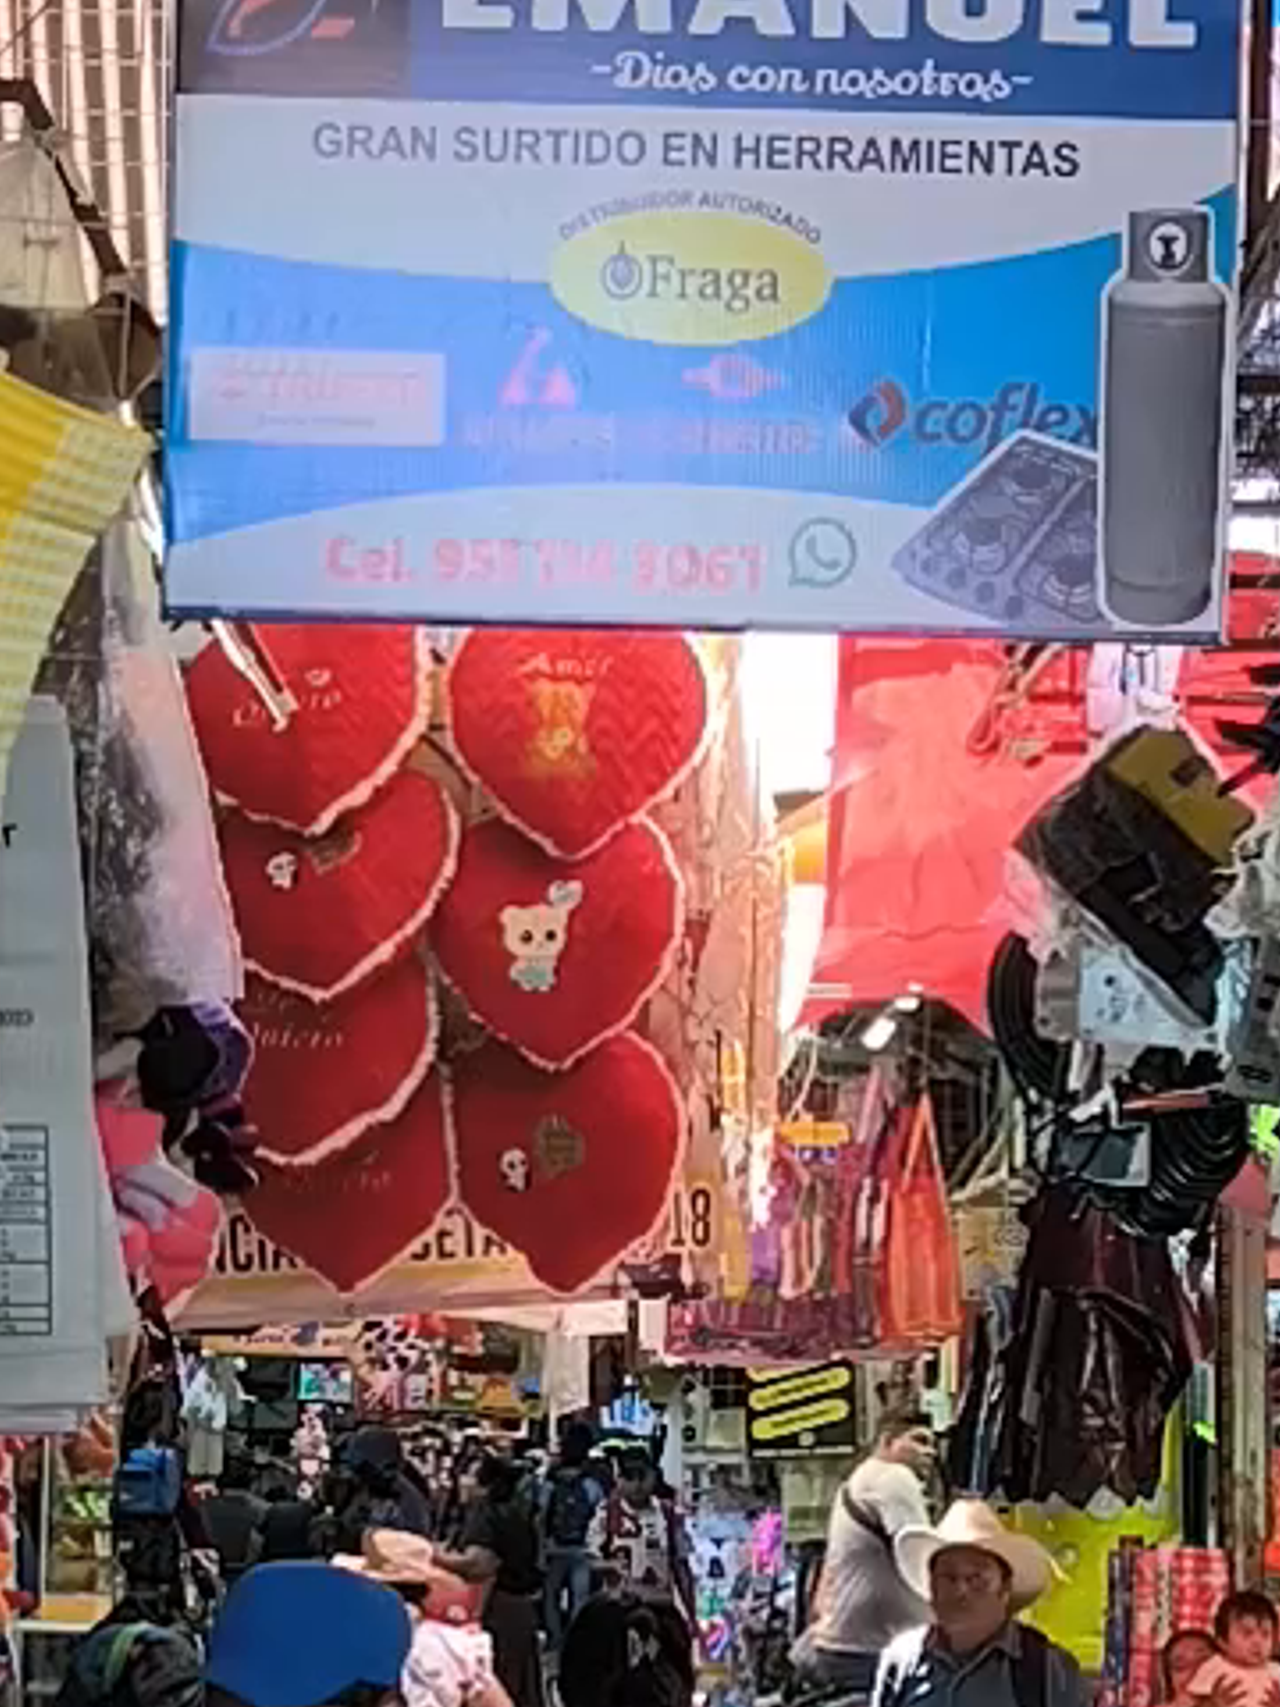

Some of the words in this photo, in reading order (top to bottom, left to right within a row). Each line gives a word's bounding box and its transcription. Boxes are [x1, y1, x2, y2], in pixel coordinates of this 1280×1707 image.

[726, 63, 811, 94] con
[312, 121, 437, 163] GRAN
[452, 126, 647, 167] SURTIDO
[661, 131, 718, 169] EN
[732, 132, 1081, 178] HERRAMIENTAS
[698, 189, 822, 245] AUTORIZADO
[644, 253, 781, 315] Fraga
